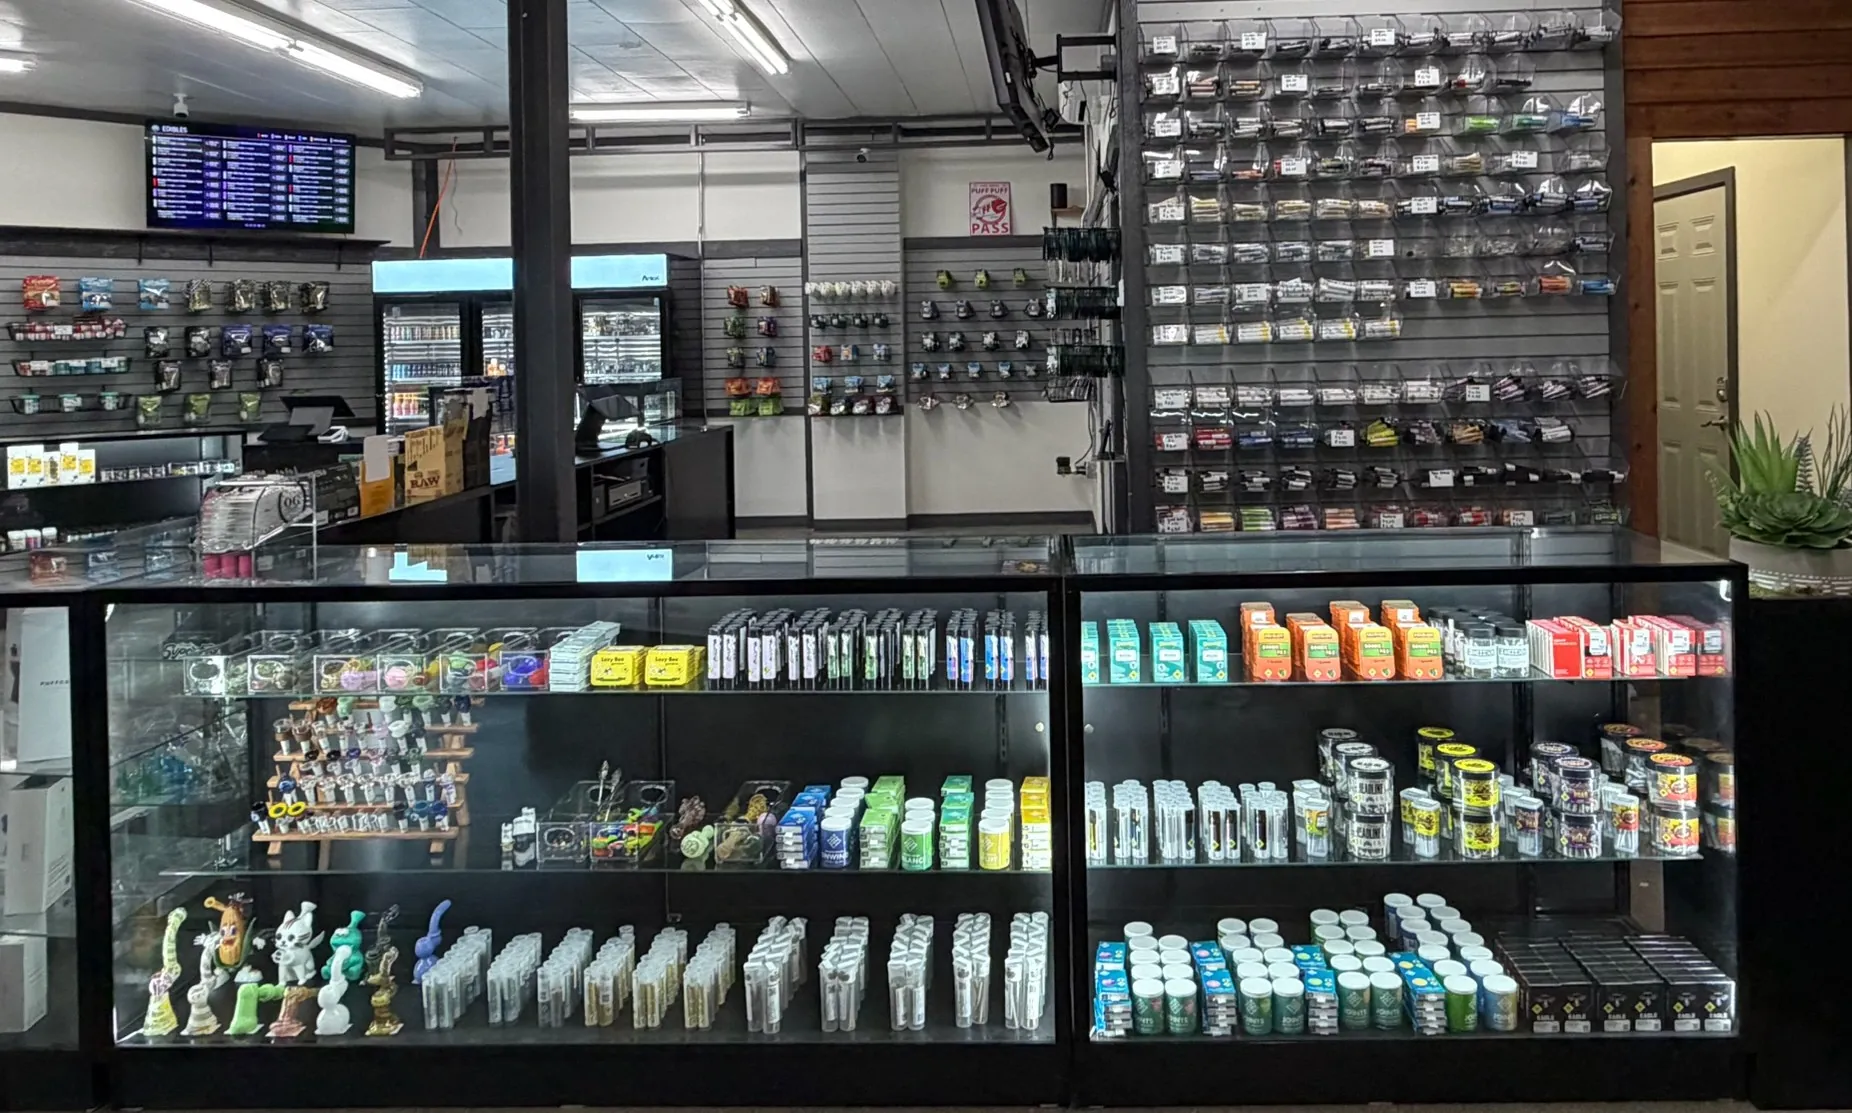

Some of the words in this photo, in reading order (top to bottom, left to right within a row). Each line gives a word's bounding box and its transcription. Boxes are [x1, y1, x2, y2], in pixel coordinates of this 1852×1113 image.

[162, 125, 188, 133] EDIBLES
[972, 223, 1009, 234] PASS
[410, 476, 440, 488] RAW
